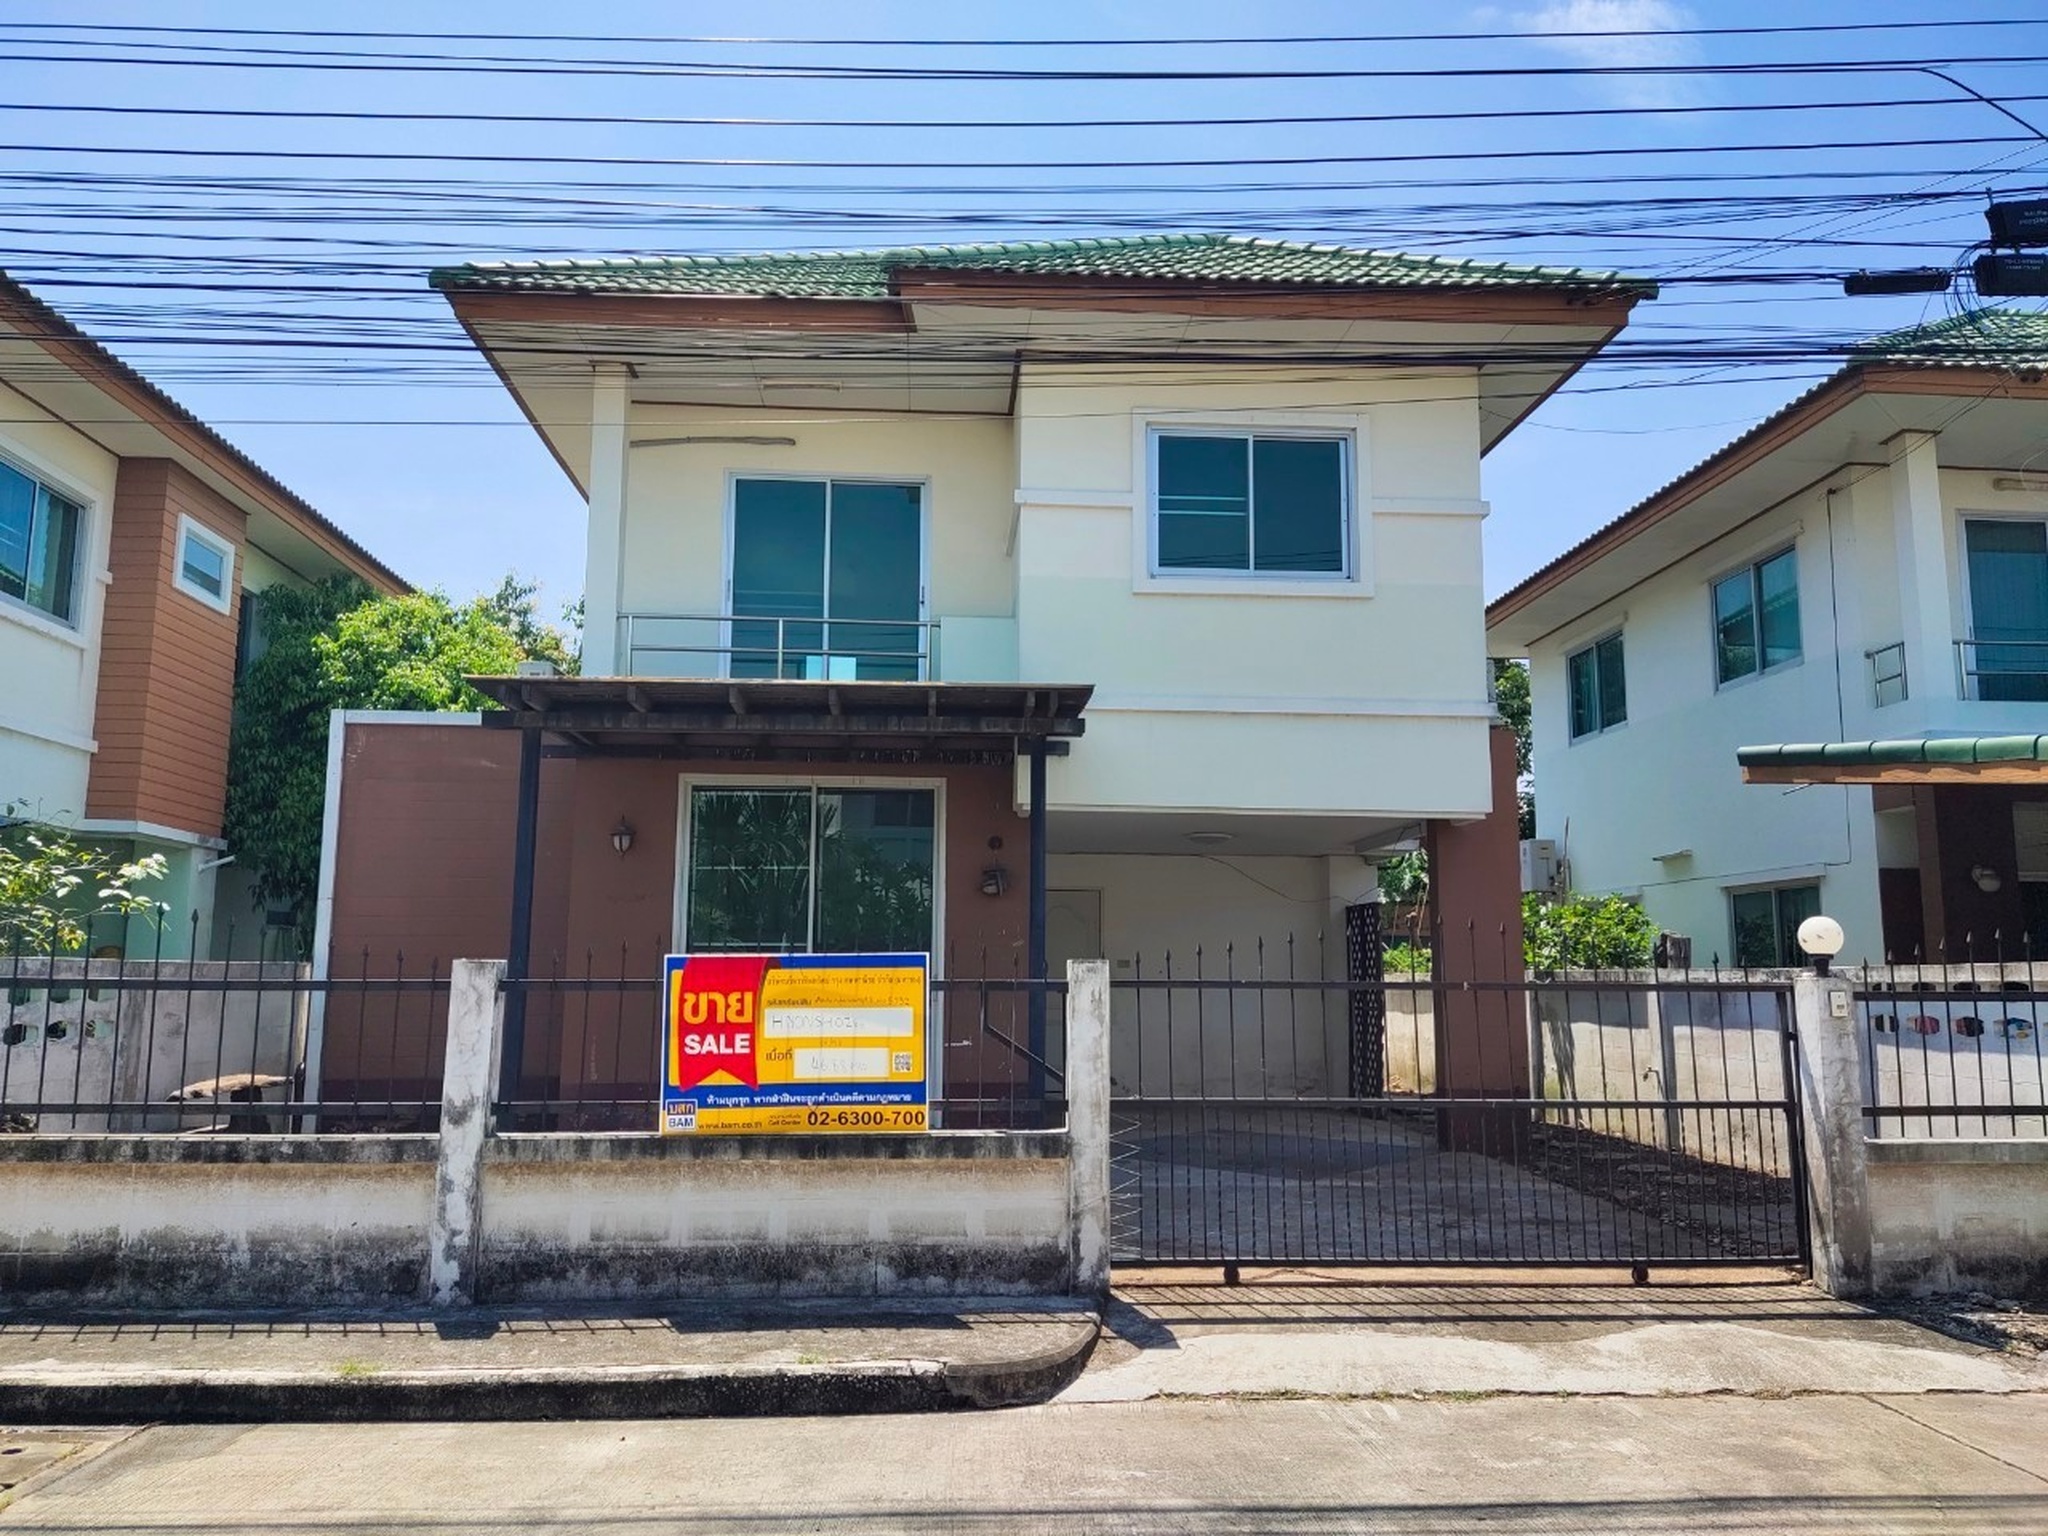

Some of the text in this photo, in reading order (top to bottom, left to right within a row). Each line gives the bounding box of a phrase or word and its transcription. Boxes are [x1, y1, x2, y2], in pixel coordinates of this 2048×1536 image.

[683, 991, 753, 1025] ขาย
[684, 1033, 751, 1055] SALE
[668, 1116, 694, 1129] BAM
[807, 1111, 925, 1127] 02-6300-700
